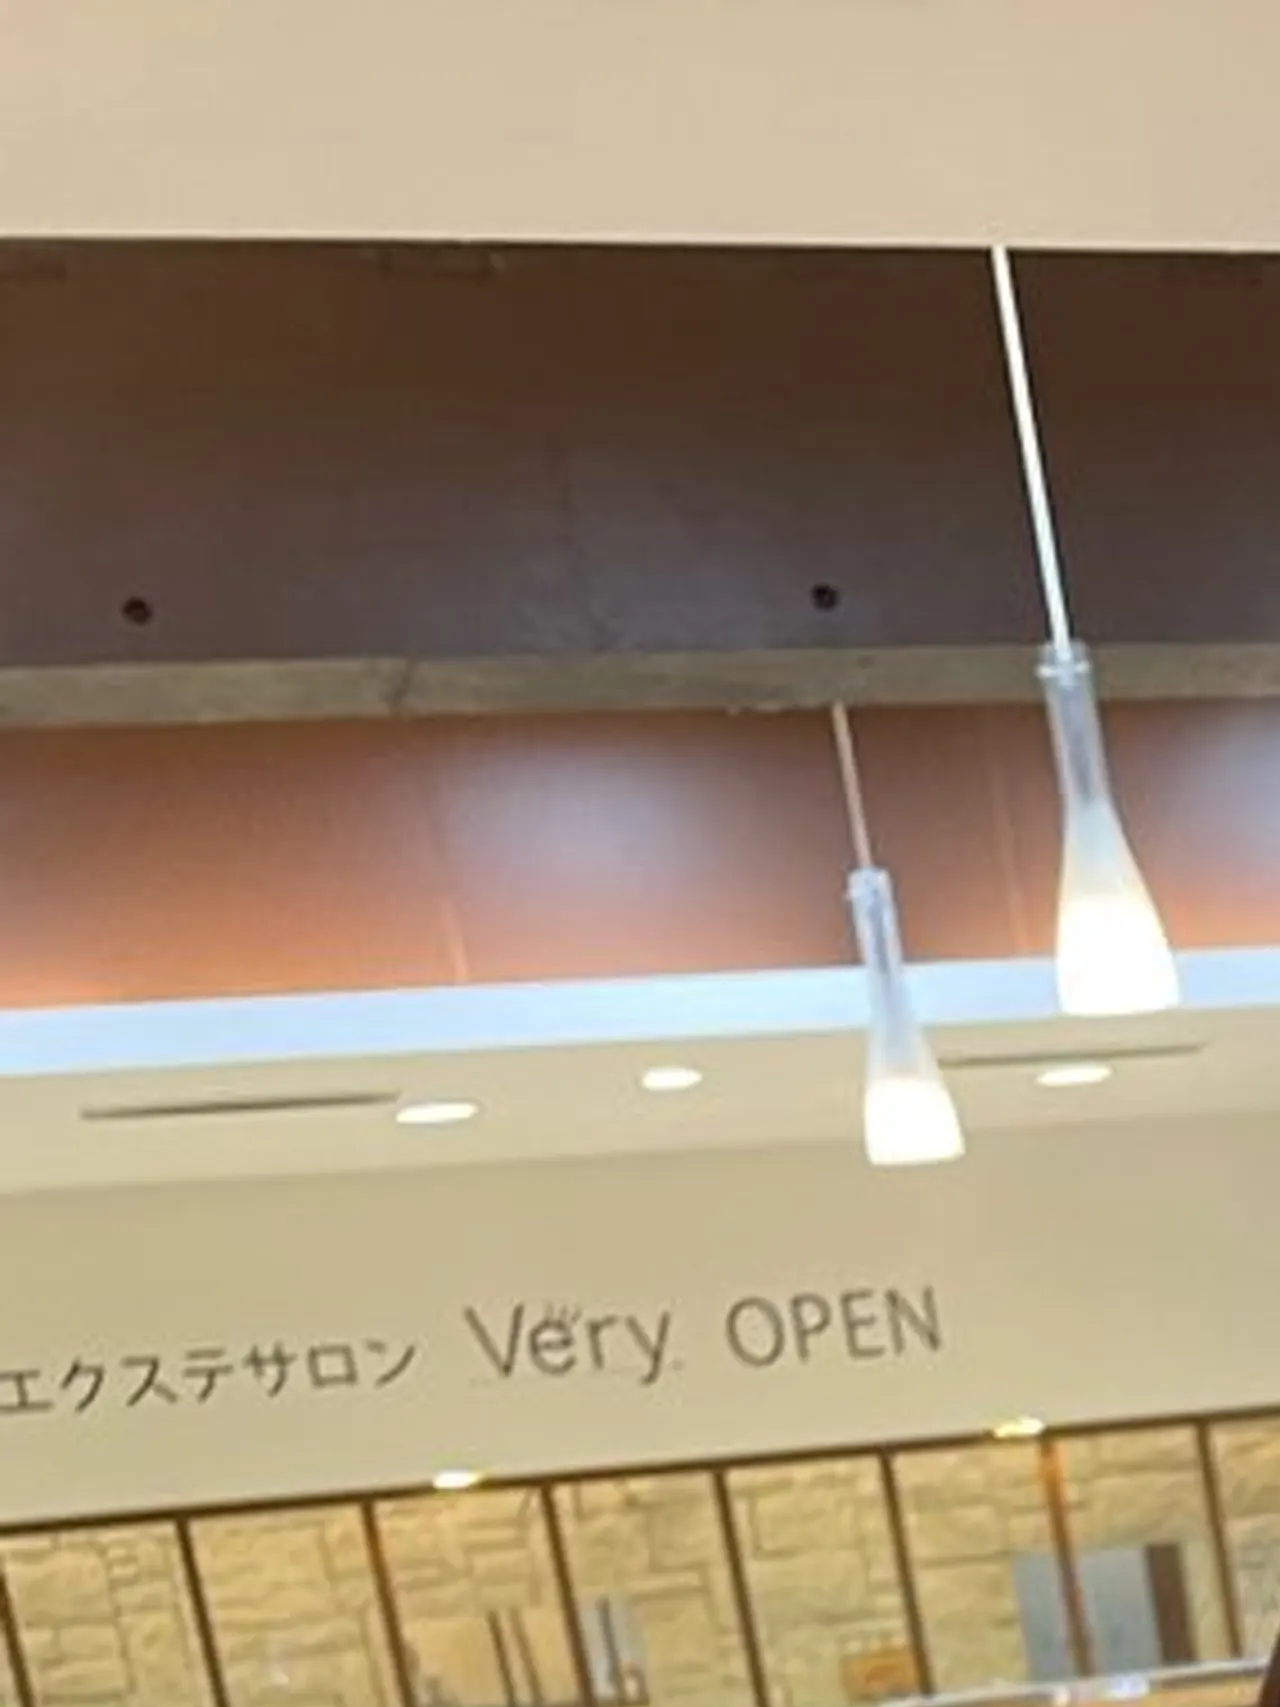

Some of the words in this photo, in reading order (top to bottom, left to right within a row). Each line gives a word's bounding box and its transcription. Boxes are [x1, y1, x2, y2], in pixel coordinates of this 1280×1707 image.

[0, 1341, 416, 1413] エクステサロン
[462, 1302, 671, 1386] Very
[724, 1285, 943, 1368] OPEN
